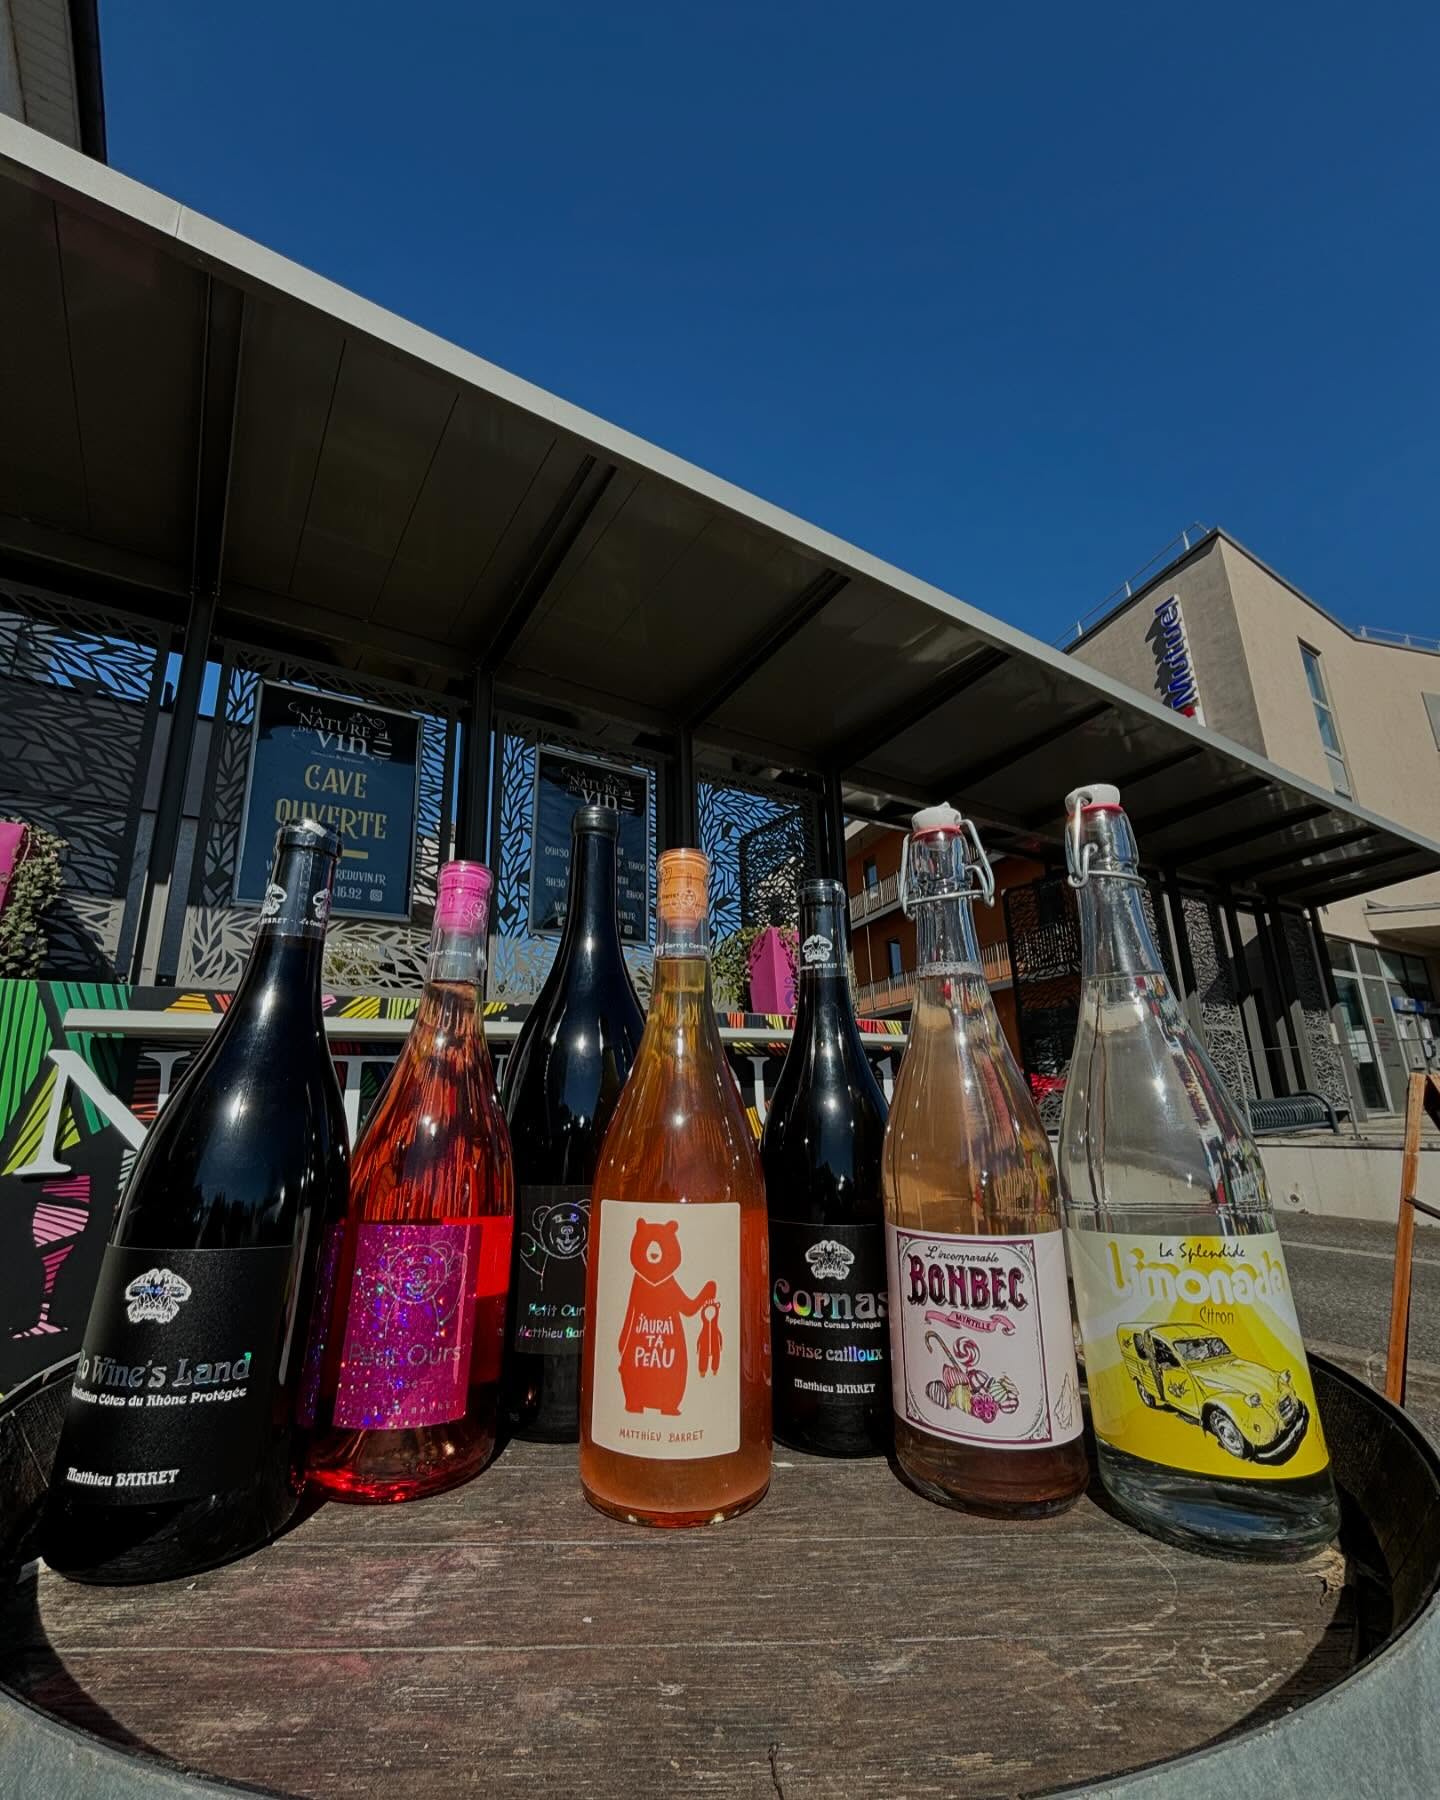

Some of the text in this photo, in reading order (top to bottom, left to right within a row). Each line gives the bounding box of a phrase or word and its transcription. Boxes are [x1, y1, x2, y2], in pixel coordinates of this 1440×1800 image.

[1154, 595, 1199, 710] Mutuel
[299, 711, 371, 738] NATURE
[304, 763, 368, 799] CAVE
[274, 798, 388, 841] OUVERTE
[1159, 1241, 1246, 1264] La Splendide
[907, 1253, 1029, 1311] BONBEC
[560, 1303, 586, 1317] Our
[773, 1278, 889, 1320] Cornas
[955, 1313, 992, 1331] MYRTILLE
[1199, 1305, 1235, 1326] Citron
[646, 1334, 665, 1349] TA
[786, 1339, 823, 1361] Brise
[91, 1354, 167, 1388] Wine's
[171, 1350, 252, 1387] Land
[634, 1346, 676, 1369] PEAU
[98, 1392, 126, 1407] Côtes
[128, 1394, 144, 1408] du
[145, 1393, 188, 1408] Rhône
[189, 1387, 247, 1405] Protégée
[794, 1378, 876, 1394] Matthieu BARRET
[66, 1466, 181, 1488] Matthieu BARRET
